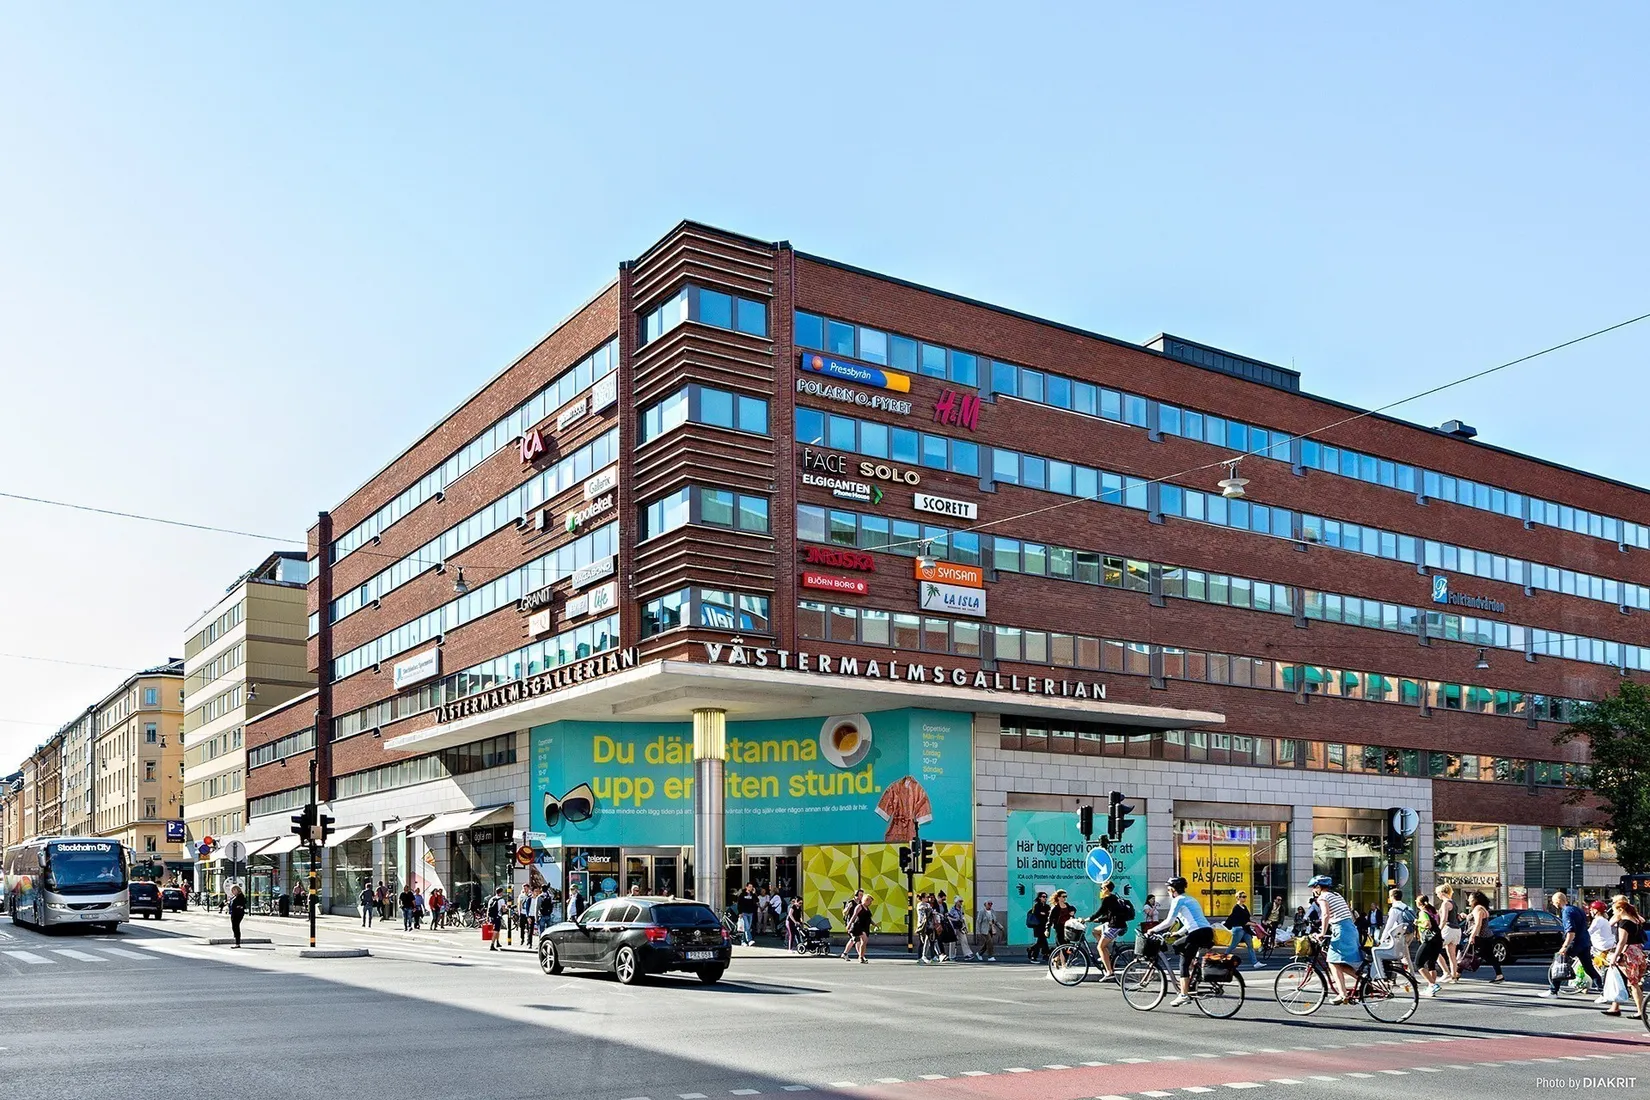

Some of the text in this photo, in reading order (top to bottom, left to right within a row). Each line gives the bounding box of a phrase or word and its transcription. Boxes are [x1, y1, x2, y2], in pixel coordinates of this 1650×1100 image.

[830, 362, 871, 380] Pressbyrån
[797, 378, 855, 403] POLARN
[871, 395, 912, 415] PYRET
[932, 388, 980, 432] H&M
[520, 429, 547, 464] ICA
[803, 447, 847, 474] FACE
[802, 473, 871, 494] ELGIGANTEN
[860, 461, 921, 486] SOLO
[574, 494, 613, 526] apoteket
[923, 496, 969, 516] SCORETT
[807, 576, 855, 590] BJÖRN BORG
[937, 567, 977, 582] SYNSAM
[520, 587, 551, 611] GRANIT
[944, 593, 980, 608] LA ISLA
[1448, 592, 1505, 613] Folktandvården
[704, 634, 1107, 700] VÄSTERMALMSGALLERIAN
[434, 647, 640, 723] VÄSTERMALMSGALLERIAN
[593, 735, 635, 764] Du
[593, 776, 655, 807] upp
[788, 763, 882, 798] stund.
[648, 808, 660, 816] lägg
[676, 808, 684, 816] på
[752, 807, 761, 815] dig
[762, 806, 774, 815] själv
[168, 823, 175, 833] P
[57, 843, 111, 853] Stockholm City
[1016, 840, 1034, 853] Här
[1037, 840, 1072, 856] bygger
[1075, 842, 1083, 853] vi
[1120, 843, 1133, 853] att
[587, 854, 611, 863] telenor
[1016, 857, 1029, 869] bli
[1032, 857, 1057, 869] ännu
[1196, 853, 1240, 868] VI HÅLLER
[1192, 868, 1243, 883] PÅ SVERIGE!
[1632, 880, 1638, 890] 3
